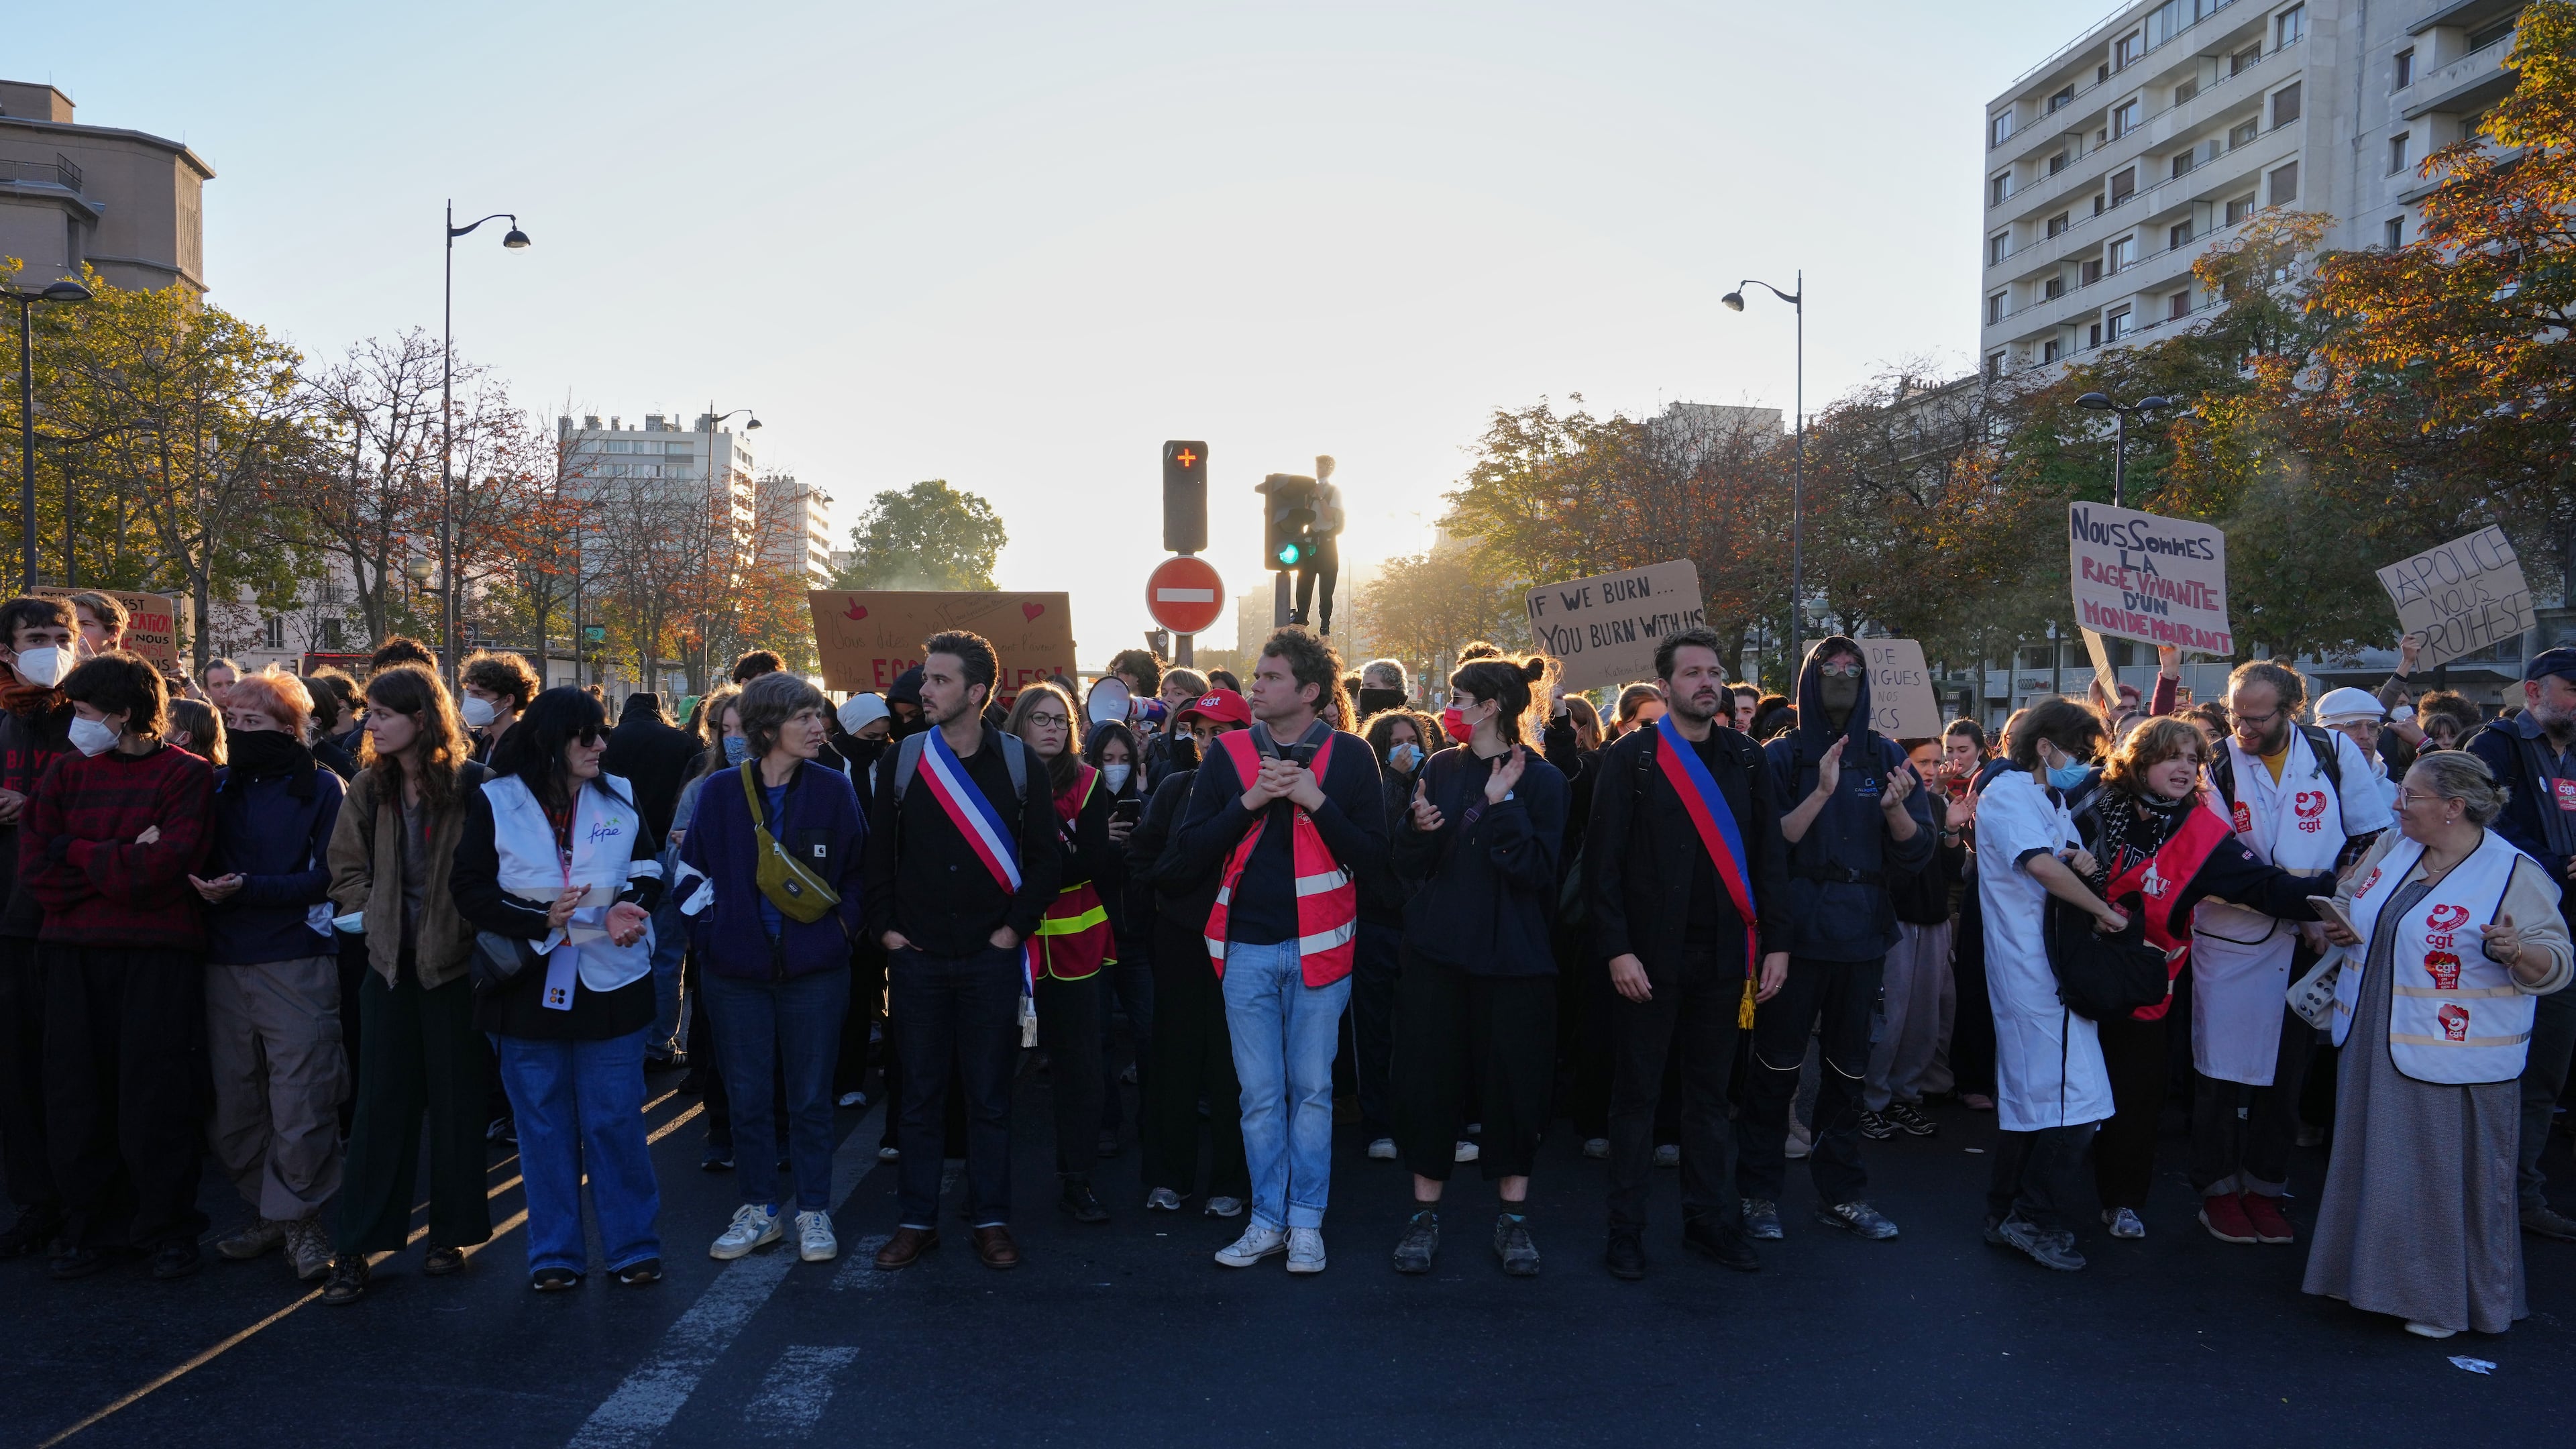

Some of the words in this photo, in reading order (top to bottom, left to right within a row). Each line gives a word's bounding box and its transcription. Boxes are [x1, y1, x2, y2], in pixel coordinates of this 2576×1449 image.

[2120, 549, 2159, 577] LA
[2379, 568, 2426, 610] LA
[2412, 527, 2517, 596] POLICE
[2082, 555, 2133, 591] RAGE
[117, 596, 145, 610] 'EST
[1527, 595, 1546, 619] IF
[1560, 586, 1593, 612] WE
[1603, 576, 1650, 604] BURN
[2123, 591, 2168, 616] D'UN
[2430, 580, 2489, 621] NOUS
[129, 612, 172, 633] CATiON
[2082, 598, 2149, 636] MONDE
[2149, 617, 2231, 654] MOURANT
[136, 634, 169, 644] NOUS
[1538, 623, 1582, 656] YOU
[1590, 619, 1636, 649] BURN
[1683, 608, 1705, 630] US
[152, 659, 170, 671] US
[1872, 648, 1896, 665] DE
[1868, 668, 1921, 686] NGUES
[1200, 696, 1221, 706] cgt
[1878, 691, 1898, 702] NOS
[1869, 707, 1900, 729] ACS
[2559, 785, 2575, 796] cgt
[2234, 808, 2247, 818] cgt
[586, 822, 622, 844] fcpe
[2298, 818, 2321, 833] cgt
[2425, 933, 2454, 949] cgt
[2435, 962, 2457, 974] cgt
[2449, 1030, 2463, 1038] cgt
